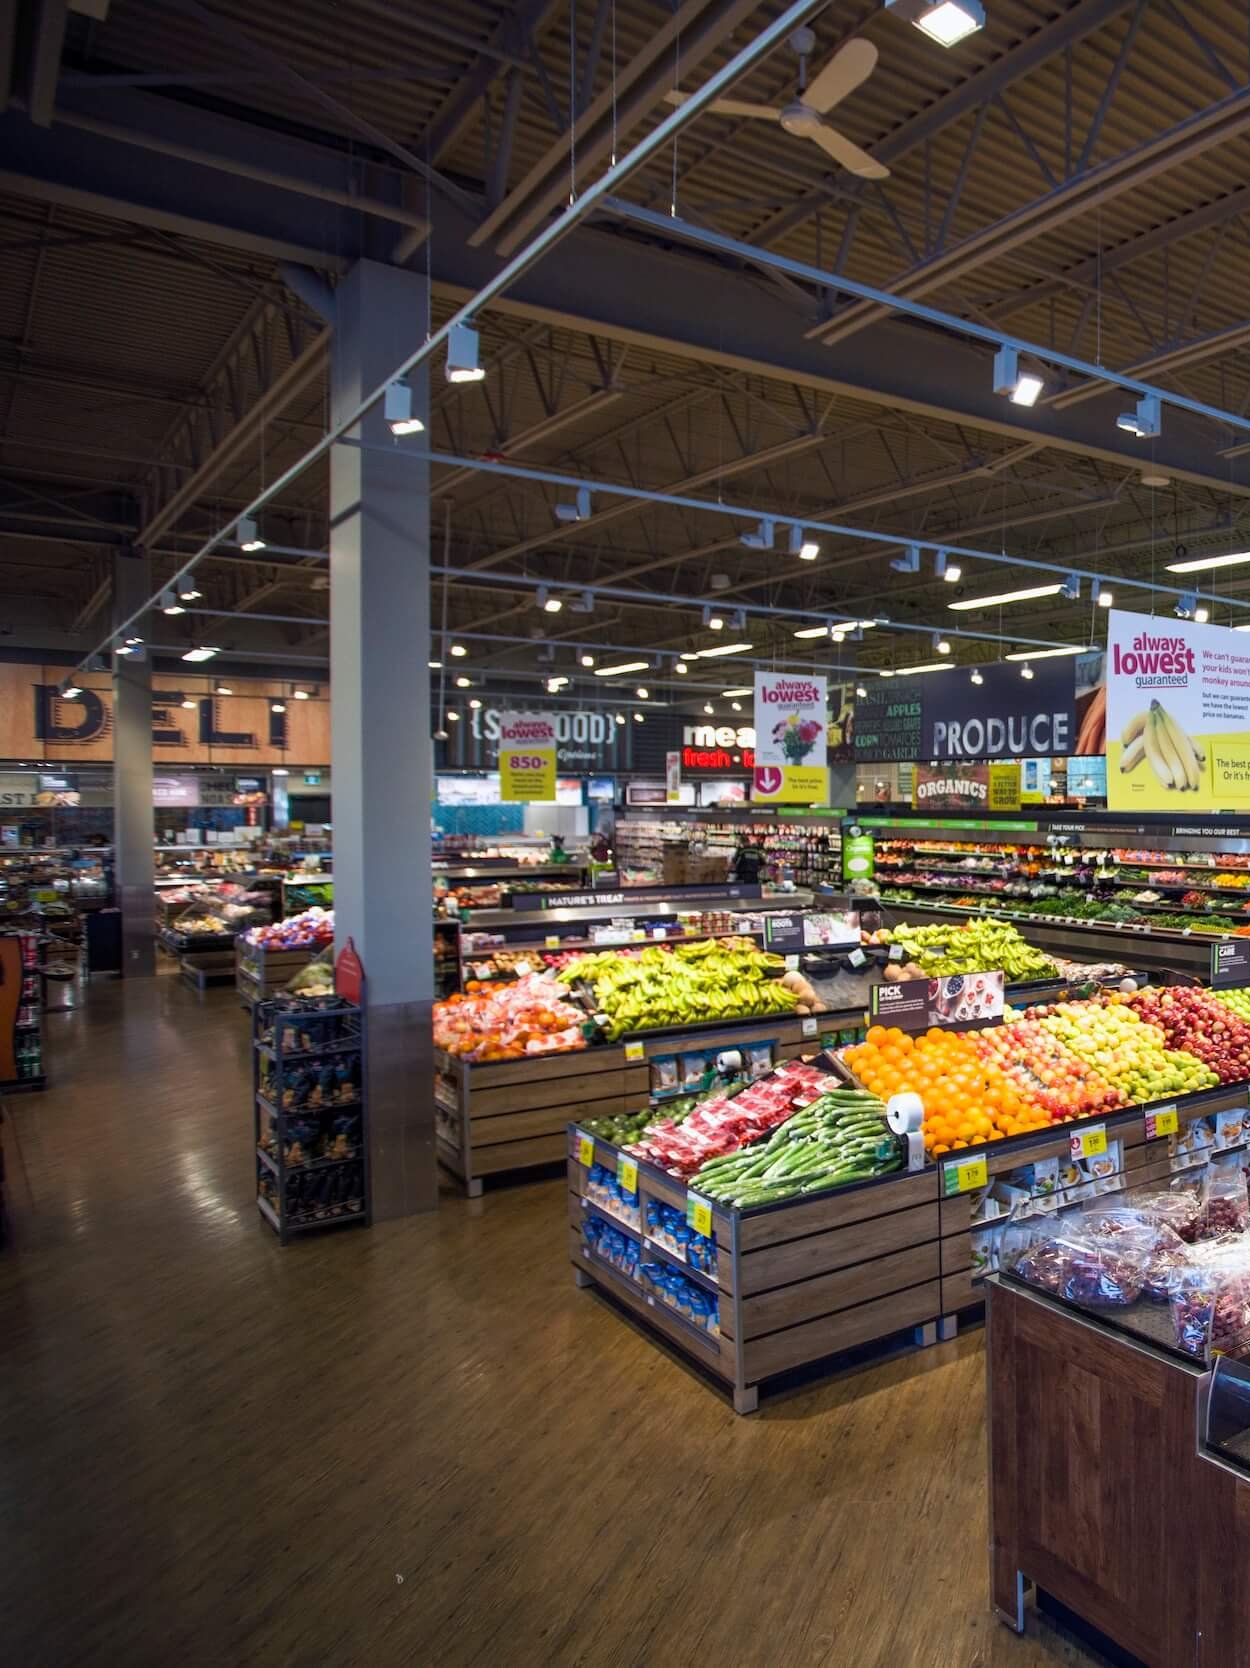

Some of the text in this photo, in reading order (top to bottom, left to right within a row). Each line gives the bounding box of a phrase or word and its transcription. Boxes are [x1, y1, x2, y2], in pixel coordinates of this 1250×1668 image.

[1133, 632, 1186, 654] always
[1114, 643, 1196, 675] lowest
[1202, 650, 1213, 659] We
[1214, 653, 1229, 661] can't
[1202, 663, 1250, 675] your kids won't
[775, 680, 813, 693] always
[1135, 673, 1188, 688] guaranteed
[1202, 676, 1229, 688] monkey
[762, 686, 820, 703] lowest
[32, 684, 290, 750] DELI
[886, 703, 921, 718] APPLES
[501, 725, 554, 739] lowest
[683, 725, 756, 749] mea
[932, 713, 1069, 757] PRODUCE
[855, 735, 880, 748] CORN
[682, 747, 731, 768] fresh
[1216, 759, 1230, 768] The
[1230, 759, 1246, 768] best
[1223, 770, 1233, 780] Or
[1233, 770, 1244, 780] it's
[917, 779, 988, 800] ORGANICS
[548, 895, 595, 906] NATURE'S
[595, 894, 625, 904] TREAT
[879, 985, 902, 997] PICK
